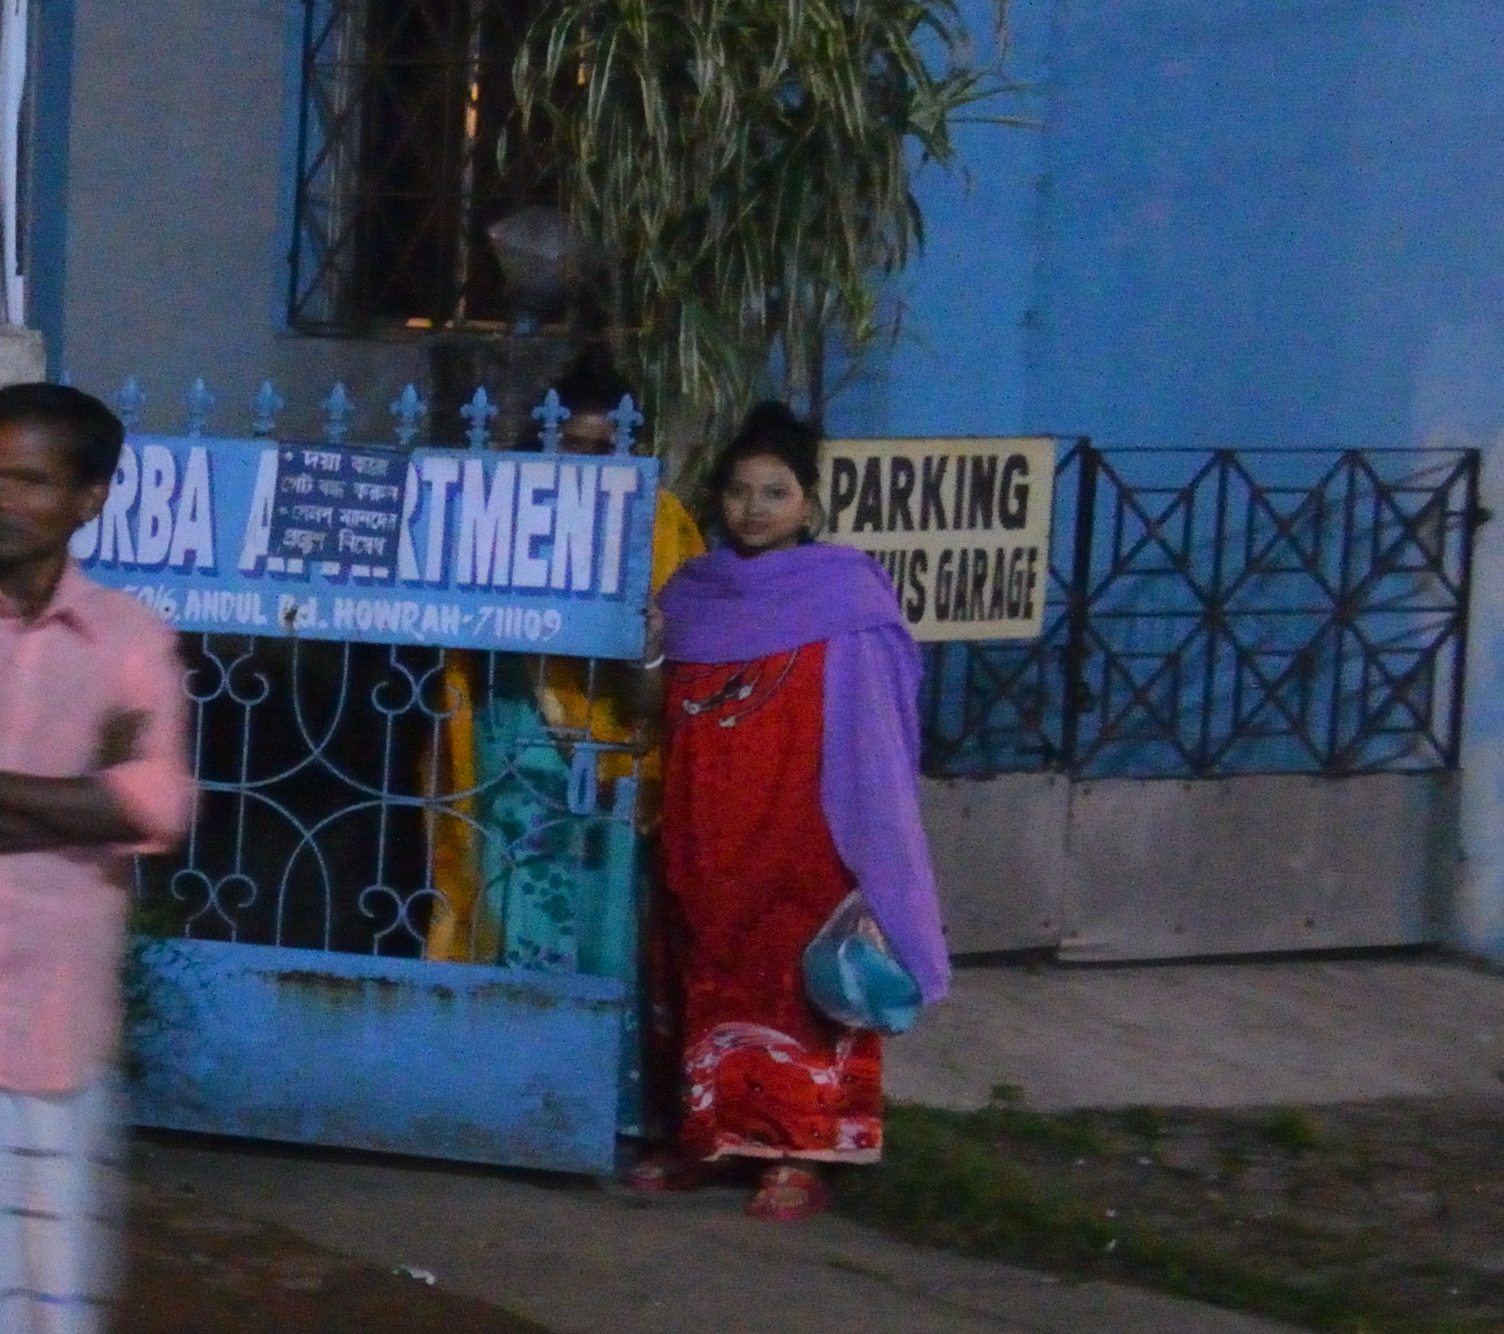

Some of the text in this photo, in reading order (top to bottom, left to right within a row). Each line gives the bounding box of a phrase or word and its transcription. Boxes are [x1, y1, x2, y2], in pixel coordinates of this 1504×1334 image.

[827, 455, 1030, 534] PARKING
[187, 588, 267, 625] ANDUL
[934, 547, 1037, 623] GARAGE
